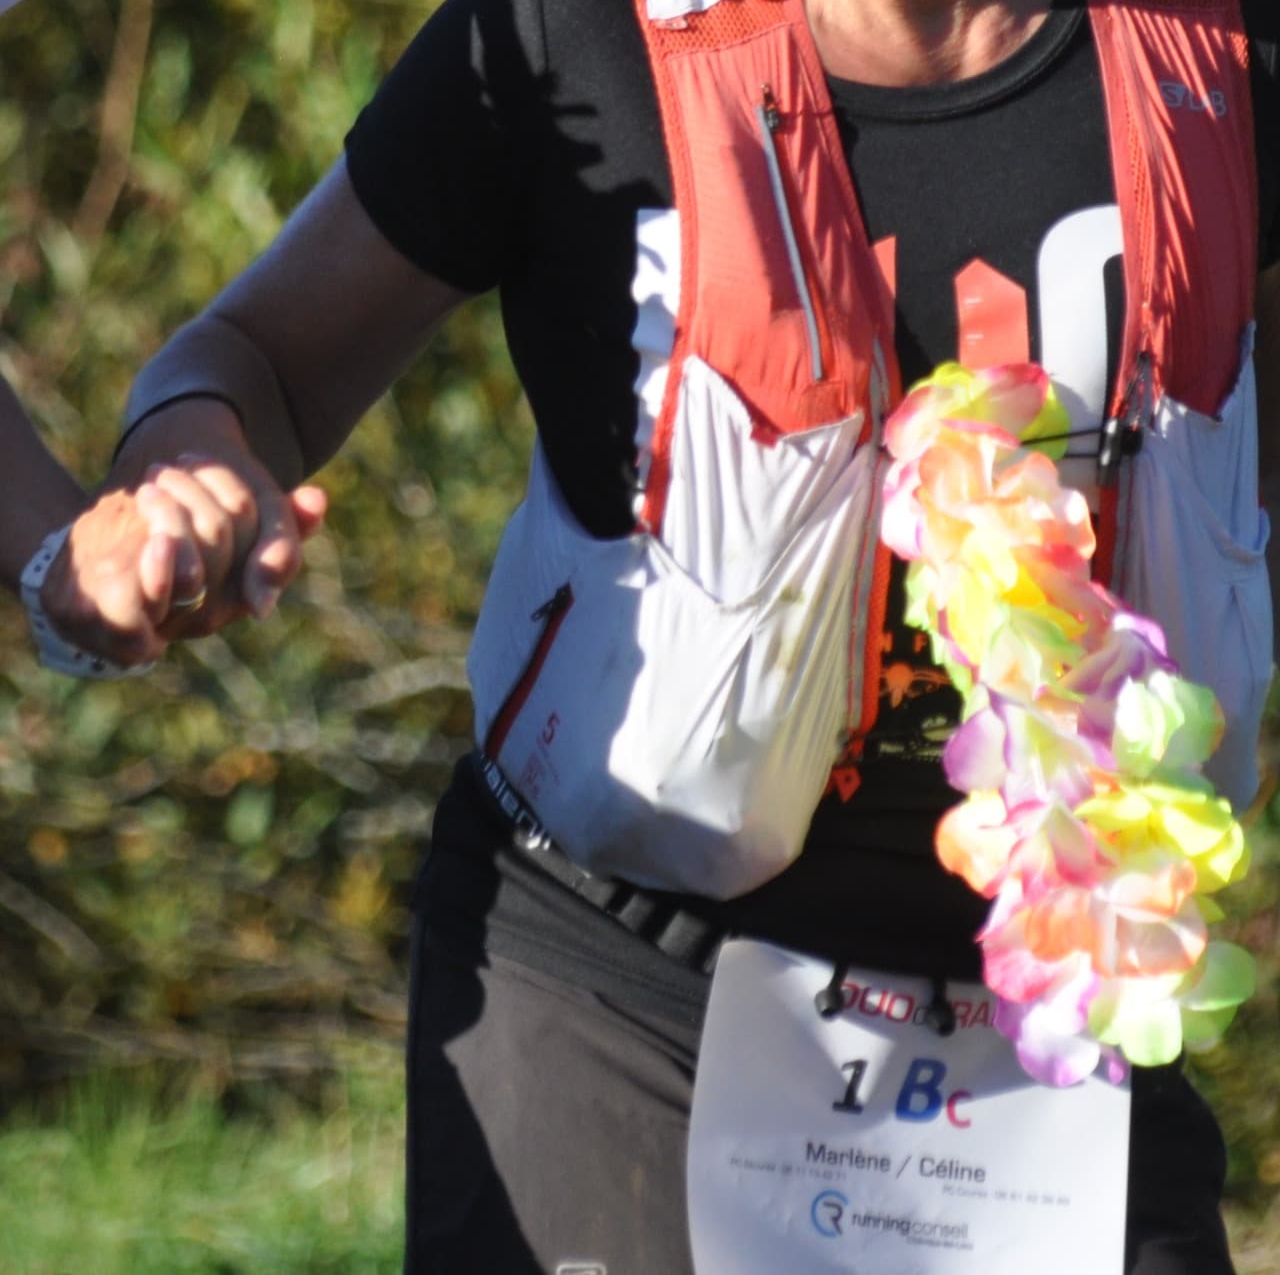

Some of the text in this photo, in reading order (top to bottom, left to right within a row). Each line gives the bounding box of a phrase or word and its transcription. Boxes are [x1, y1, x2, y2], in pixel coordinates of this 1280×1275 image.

[831, 1059, 869, 1115] 1
[805, 1141, 892, 1173] Marlène
[919, 1155, 987, 1184] Céline
